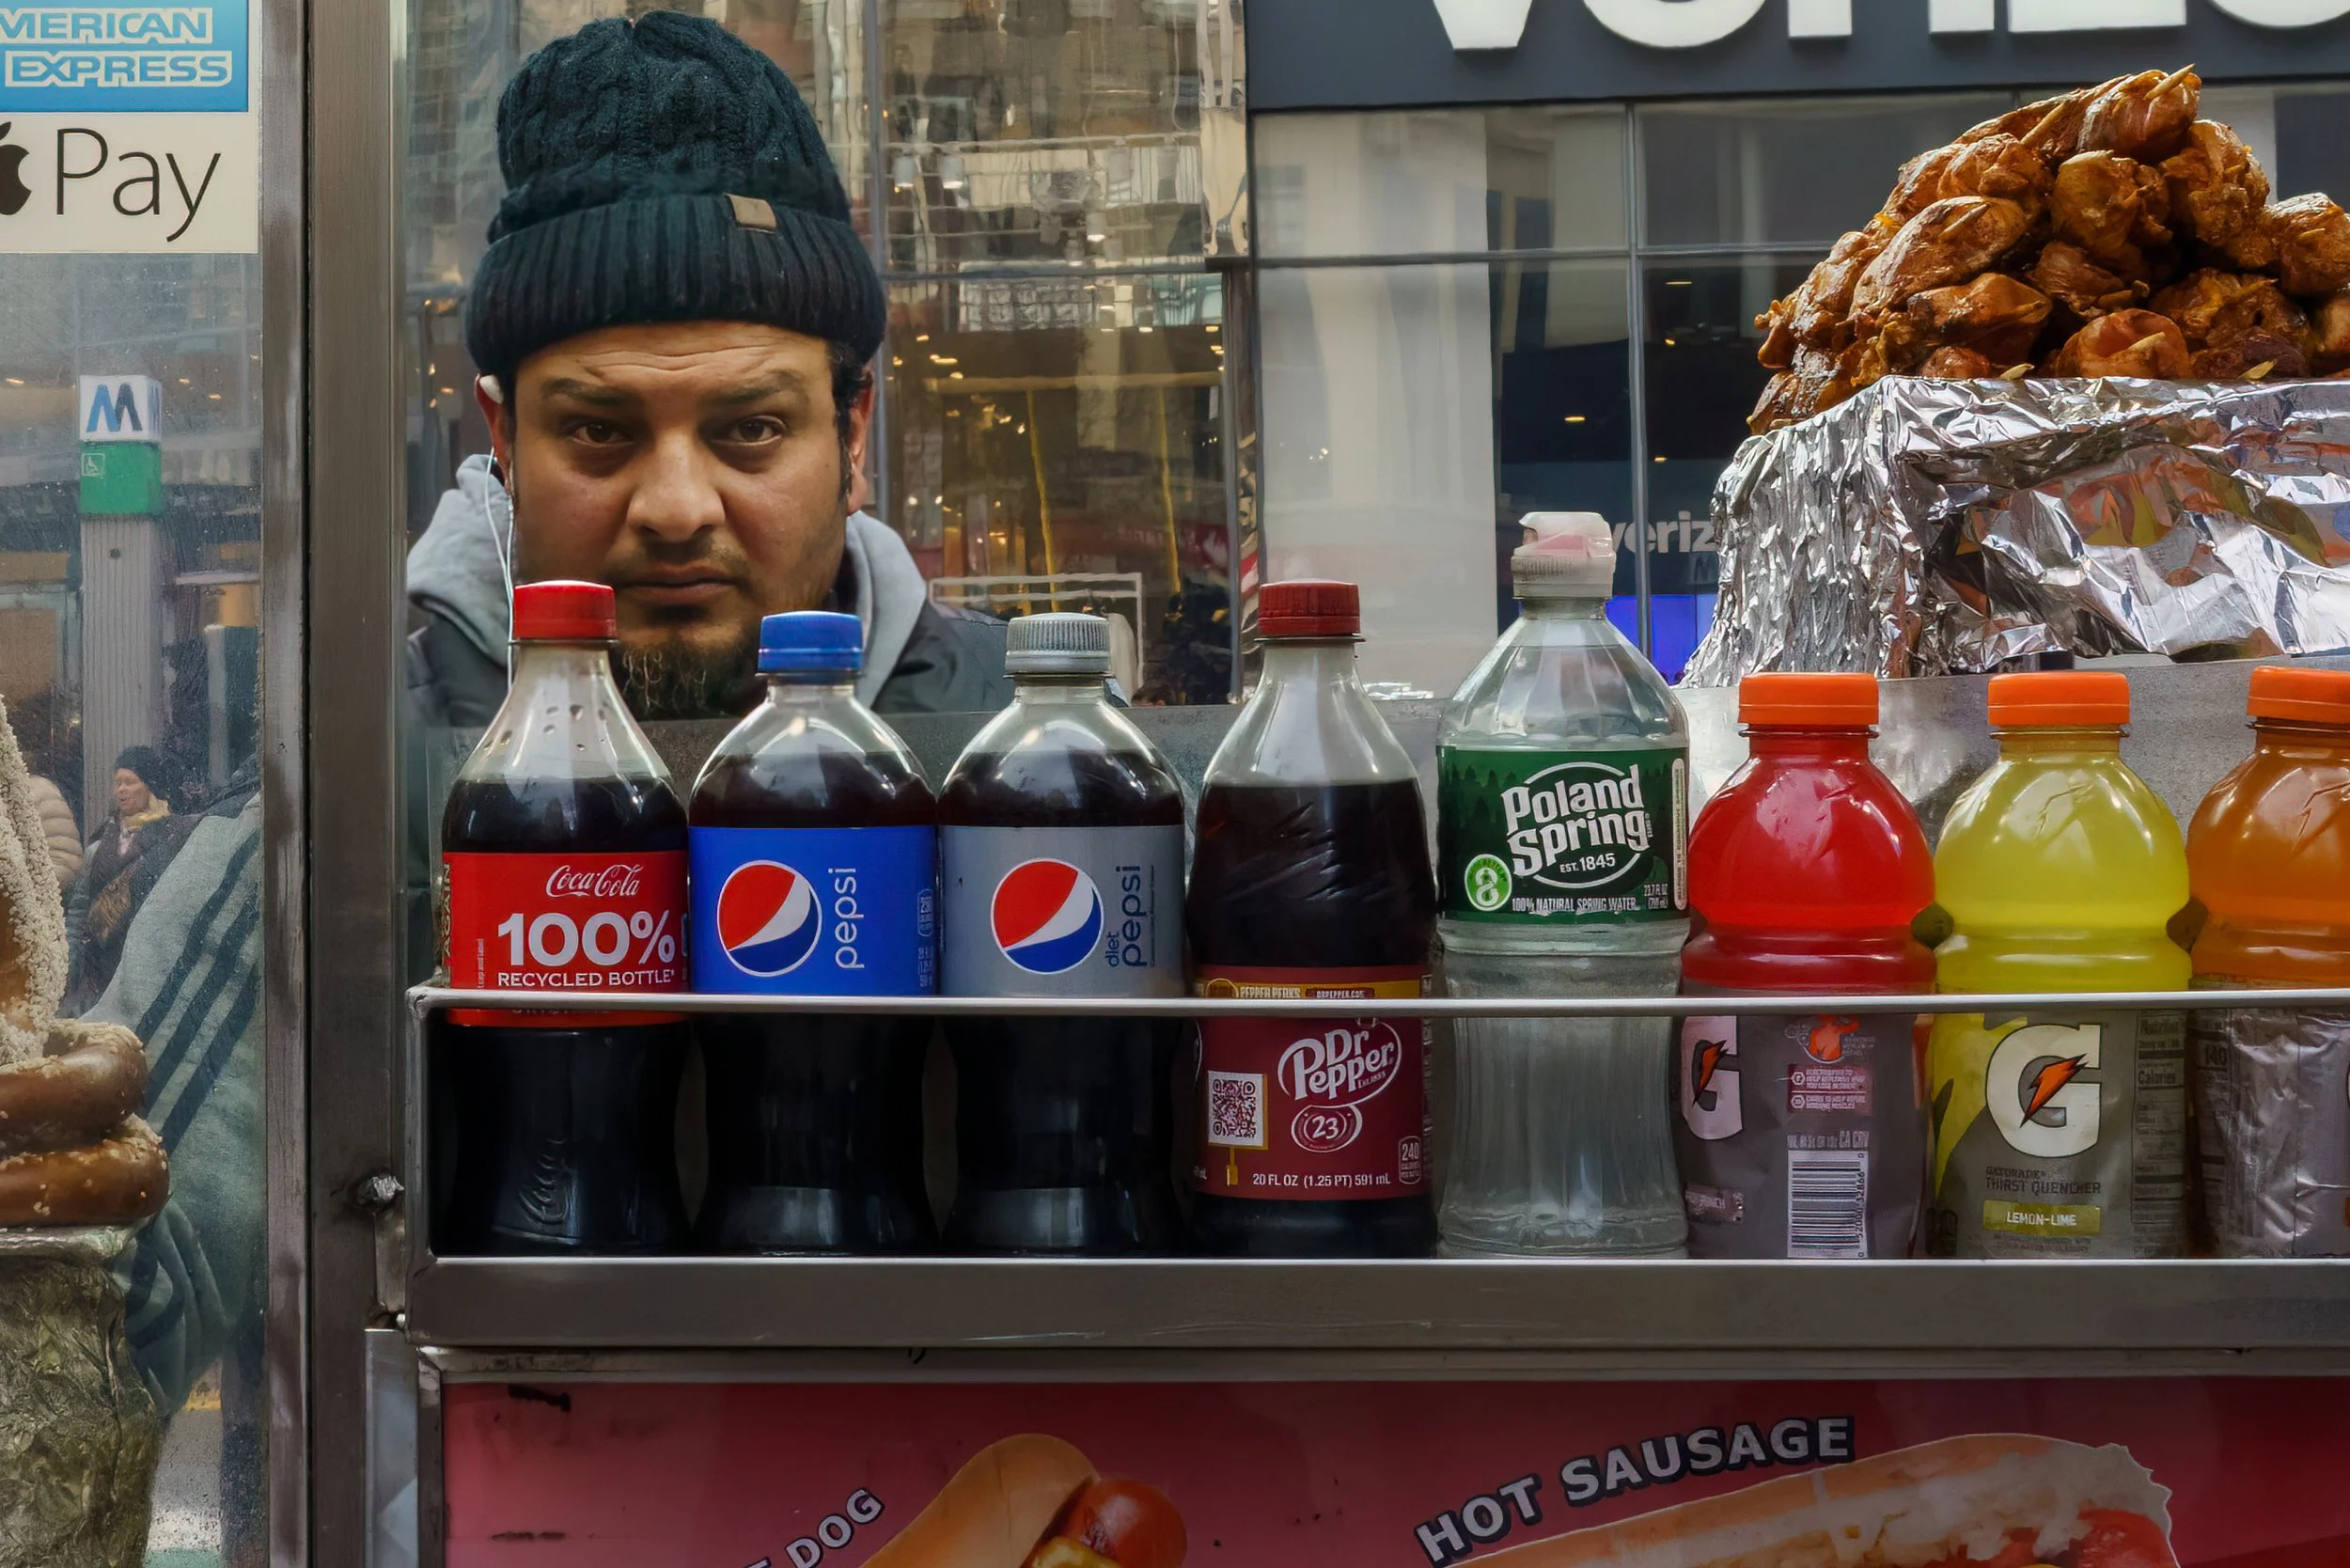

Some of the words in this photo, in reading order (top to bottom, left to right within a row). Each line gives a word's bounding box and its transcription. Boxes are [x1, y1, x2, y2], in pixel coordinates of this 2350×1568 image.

[12, 55, 228, 83] EXPRESS
[56, 128, 221, 242] Pay
[1500, 763, 1645, 837] Poland
[1507, 810, 1651, 877] Spring
[545, 863, 644, 899] Coca-Cola
[1559, 861, 1579, 873] EST.
[1579, 853, 1616, 872] 1845
[827, 867, 865, 970] pepsi
[1116, 865, 1148, 968] pepsi
[1512, 897, 1535, 912] 100%
[1536, 897, 1574, 912] NATURAL
[1577, 897, 1606, 912] SPRING
[497, 909, 676, 967] 100%
[1105, 932, 1119, 967] diet
[498, 972, 603, 987] RECYCLED
[1324, 1028, 1370, 1066] Dr
[1277, 1038, 1395, 1101] Pepper
[1986, 1023, 2104, 1158] G
[1311, 1115, 1340, 1140] 23
[1402, 1143, 1419, 1161] 240
[1252, 1173, 1266, 1186] 20
[1268, 1173, 1281, 1186] FL
[1284, 1174, 1298, 1186] OZ
[1304, 1174, 1331, 1188] (1.25
[1335, 1174, 1352, 1188] PT)
[1355, 1173, 1373, 1186] 591
[1376, 1172, 1391, 1184] mL
[1985, 1177, 2027, 1193] THIRST
[2006, 1211, 2076, 1227] LEMON-LIME
[1416, 1476, 1538, 1563] HOT
[1560, 1417, 1851, 1502] SAUSAGE
[784, 1487, 885, 1568] DOG
